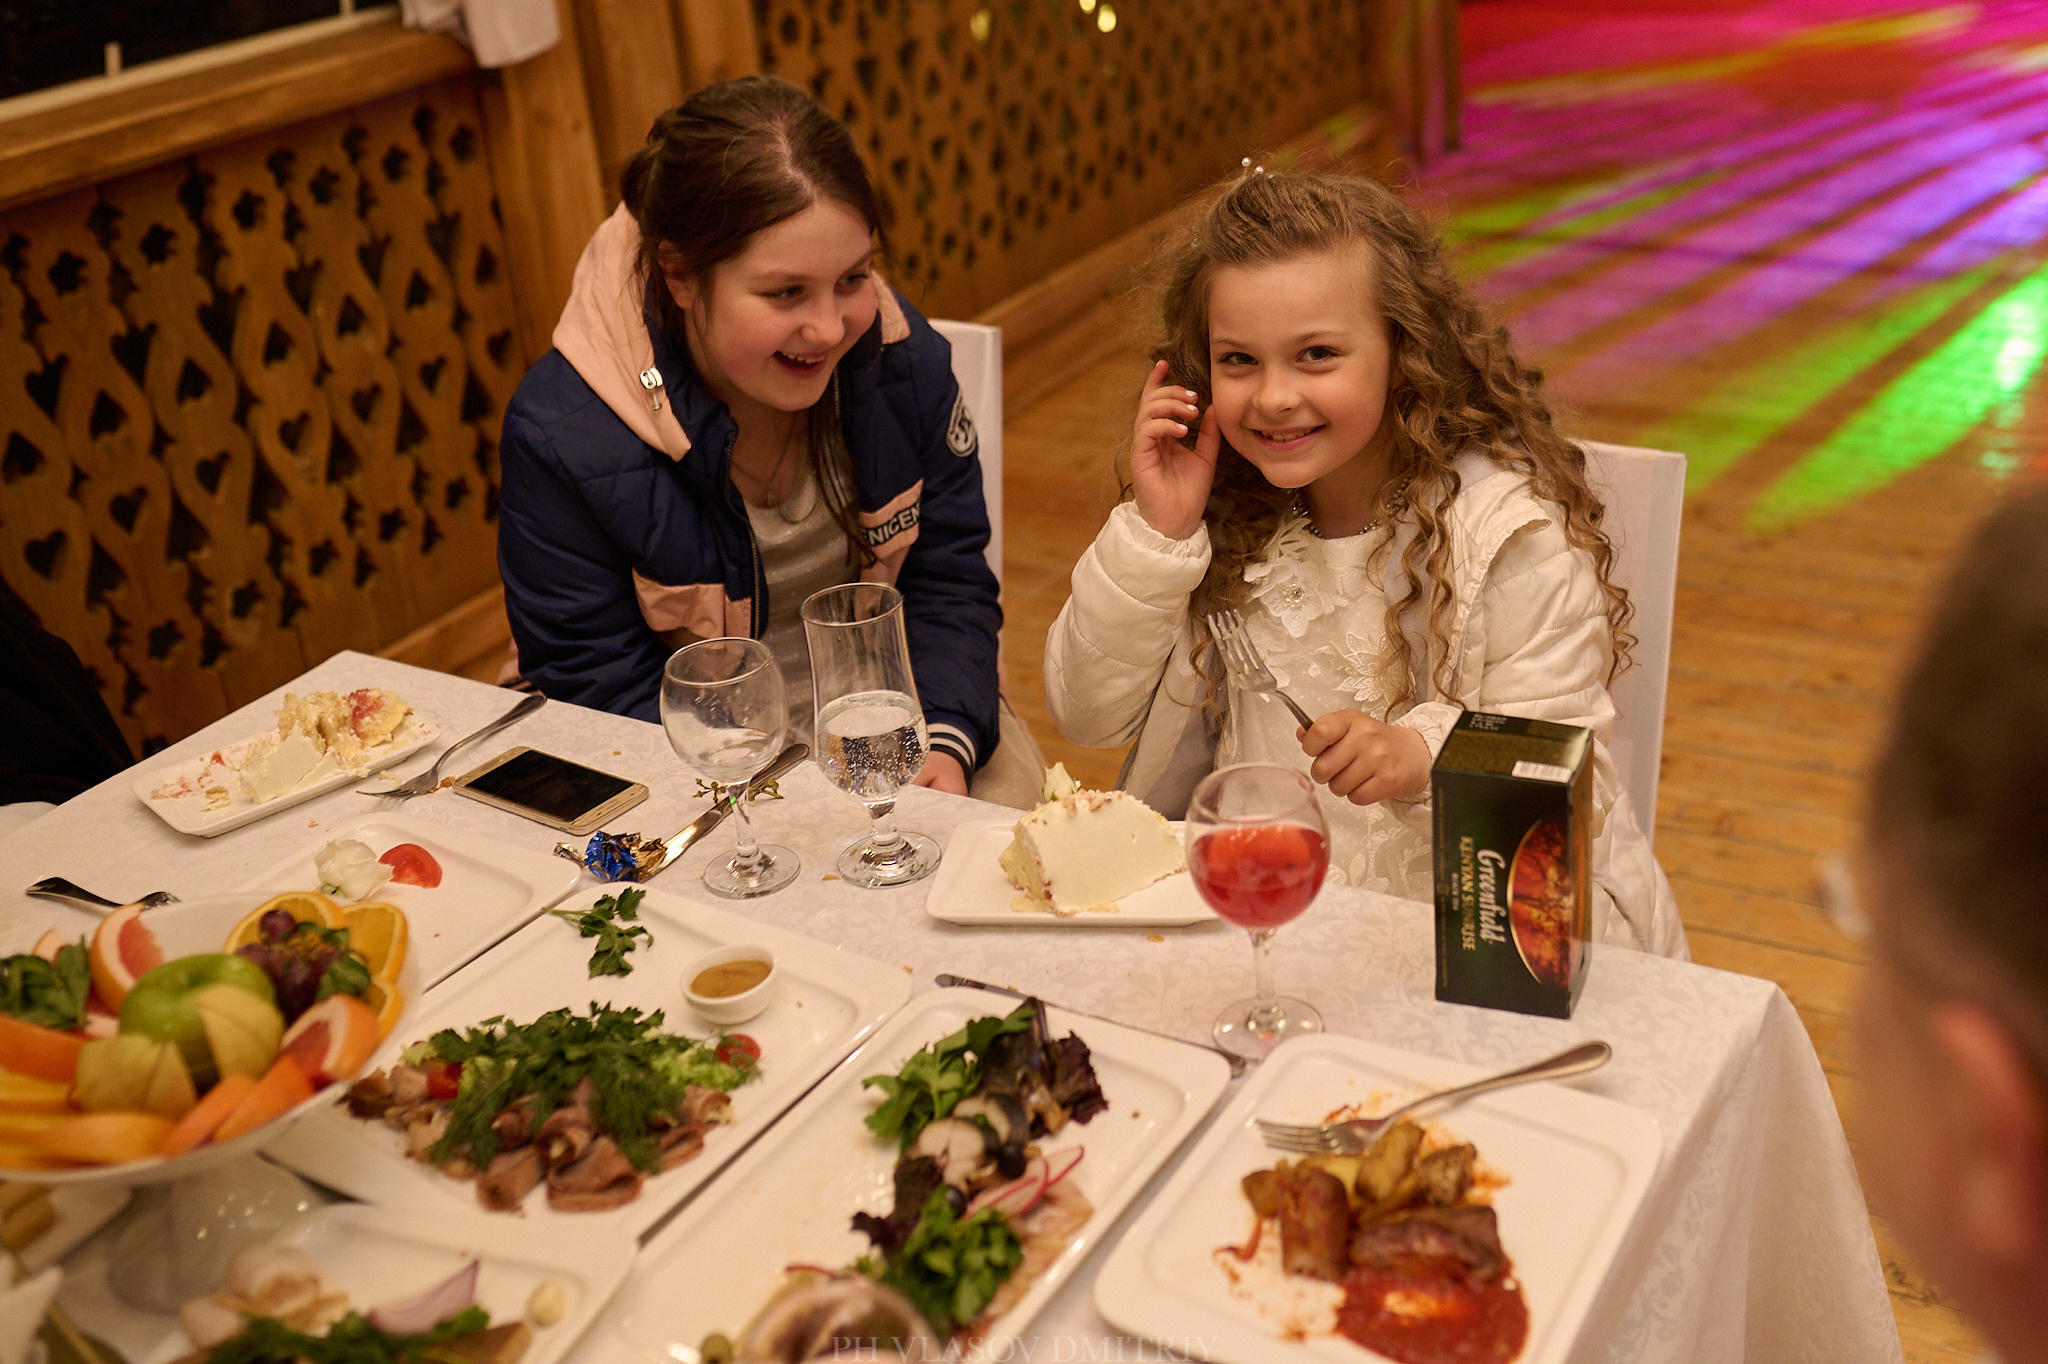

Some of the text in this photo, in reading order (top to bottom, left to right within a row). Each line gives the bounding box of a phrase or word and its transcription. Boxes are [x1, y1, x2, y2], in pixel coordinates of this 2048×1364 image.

[1460, 836, 1476, 951] KENYAN SUNRISE
[1477, 849, 1507, 942] Greenfield
